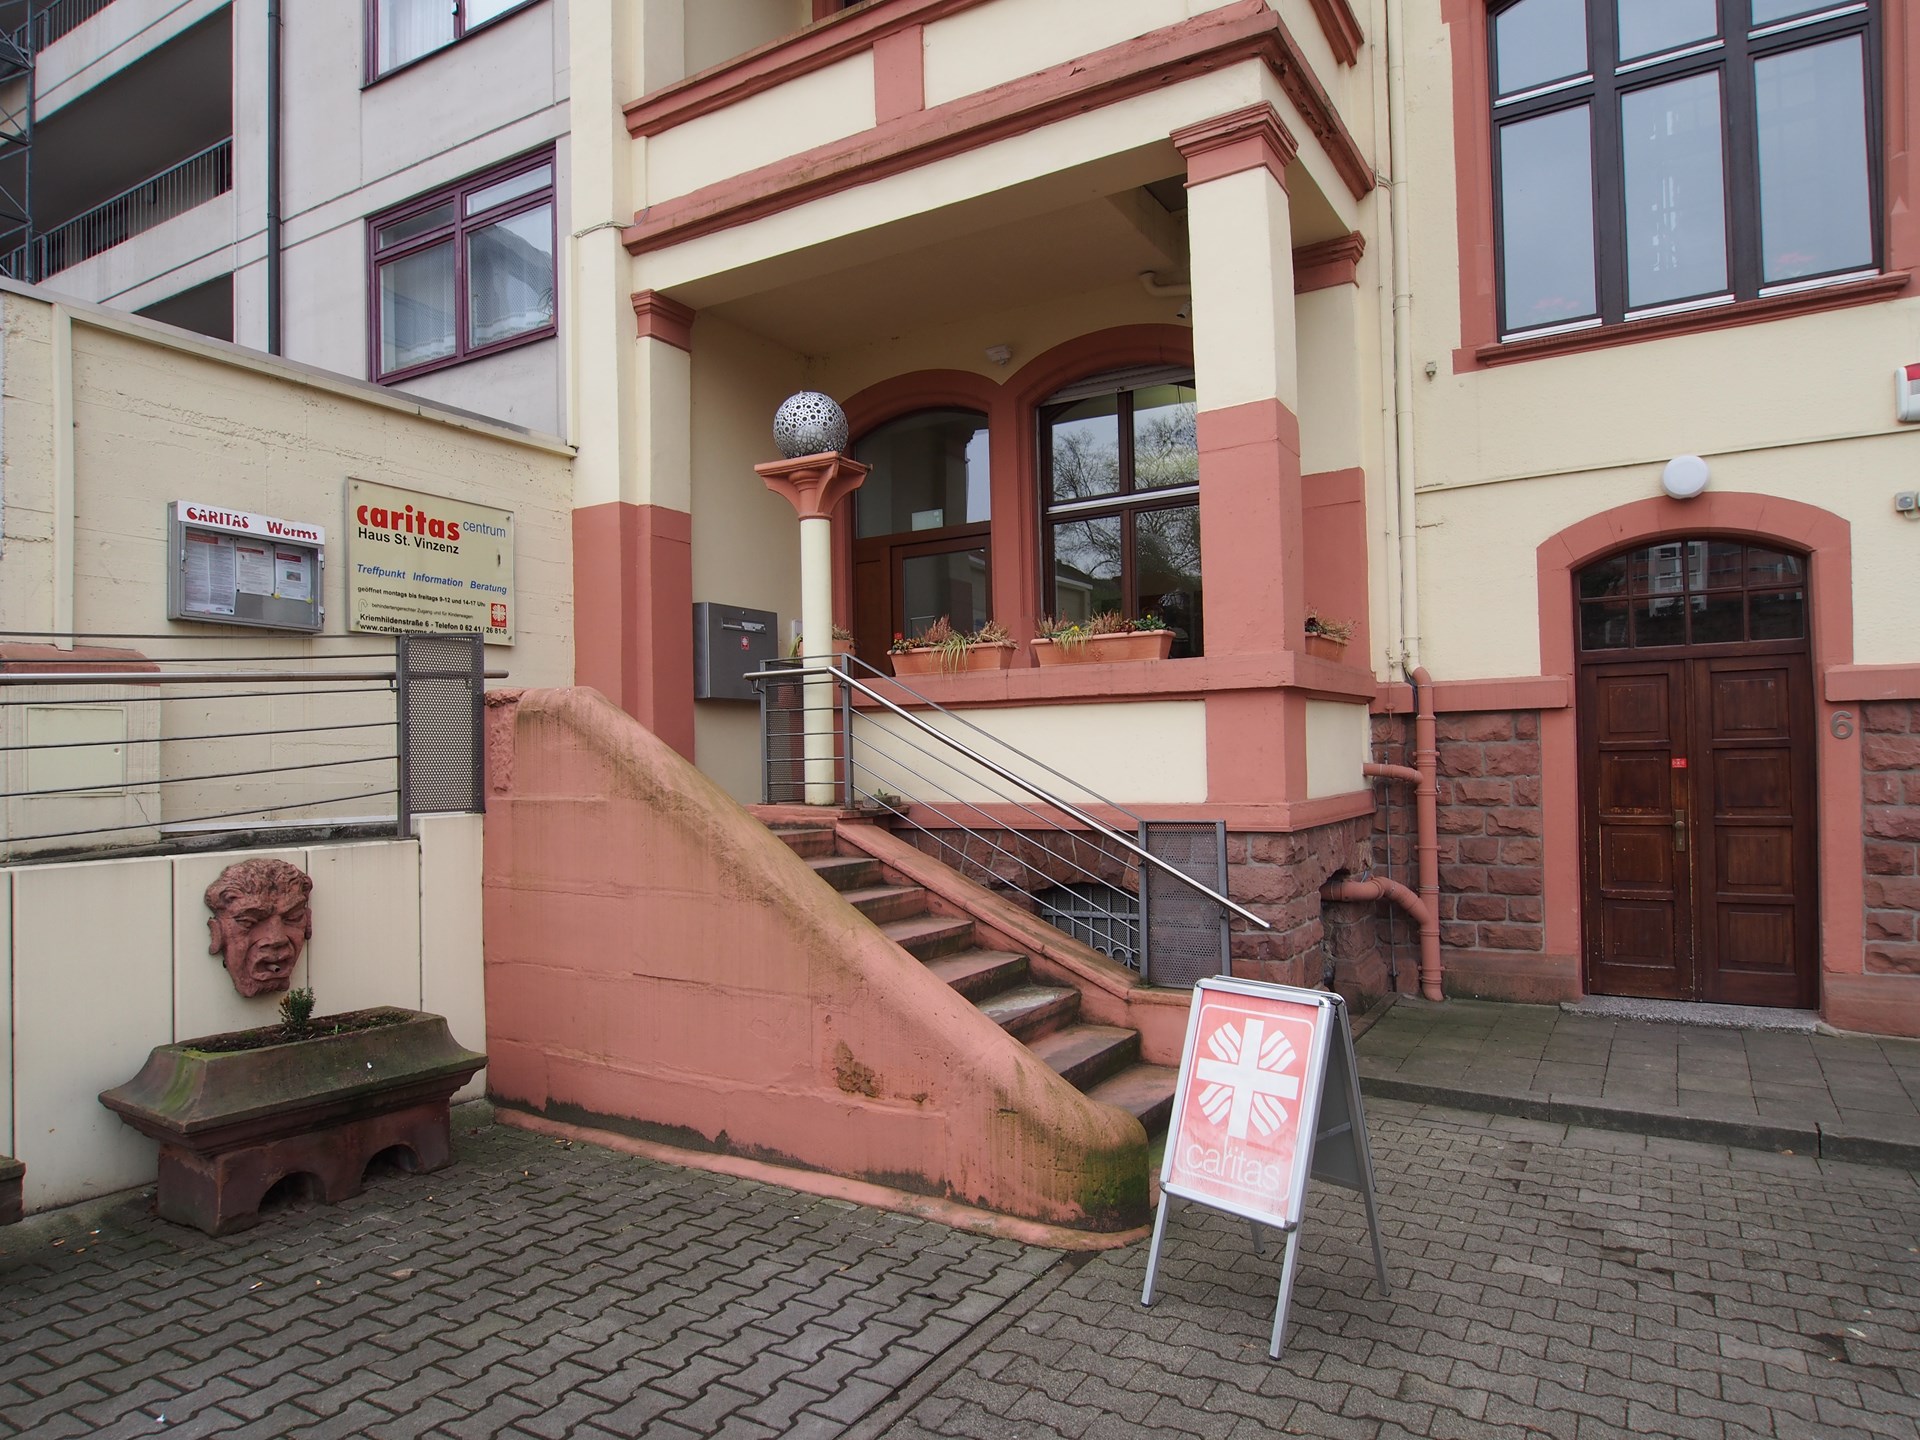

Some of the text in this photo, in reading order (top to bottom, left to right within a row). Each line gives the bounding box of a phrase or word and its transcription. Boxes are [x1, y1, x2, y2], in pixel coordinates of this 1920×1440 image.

[186, 507, 318, 541] CARITAS Worms
[357, 505, 506, 541] caritas centrum
[358, 527, 460, 555] Haus St. Vinzenz
[357, 563, 507, 596] Treffpunkt Information Beratung
[357, 586, 382, 595] geöffnet
[383, 590, 408, 599] montags
[408, 592, 418, 600] bis
[418, 593, 439, 603] freitags
[439, 596, 451, 604] 9-12
[451, 597, 462, 605] und
[463, 598, 477, 606] 14-17
[359, 624, 437, 635] www.caritas-wormsd
[360, 613, 424, 628] Kriemhildenstraße
[424, 619, 430, 628] 6
[435, 620, 458, 631] Telefon
[459, 622, 464, 631] 0
[474, 624, 481, 632] 41
[486, 626, 493, 634] 26
[1830, 710, 1854, 739] 6
[1186, 1144, 1280, 1192] caritas
